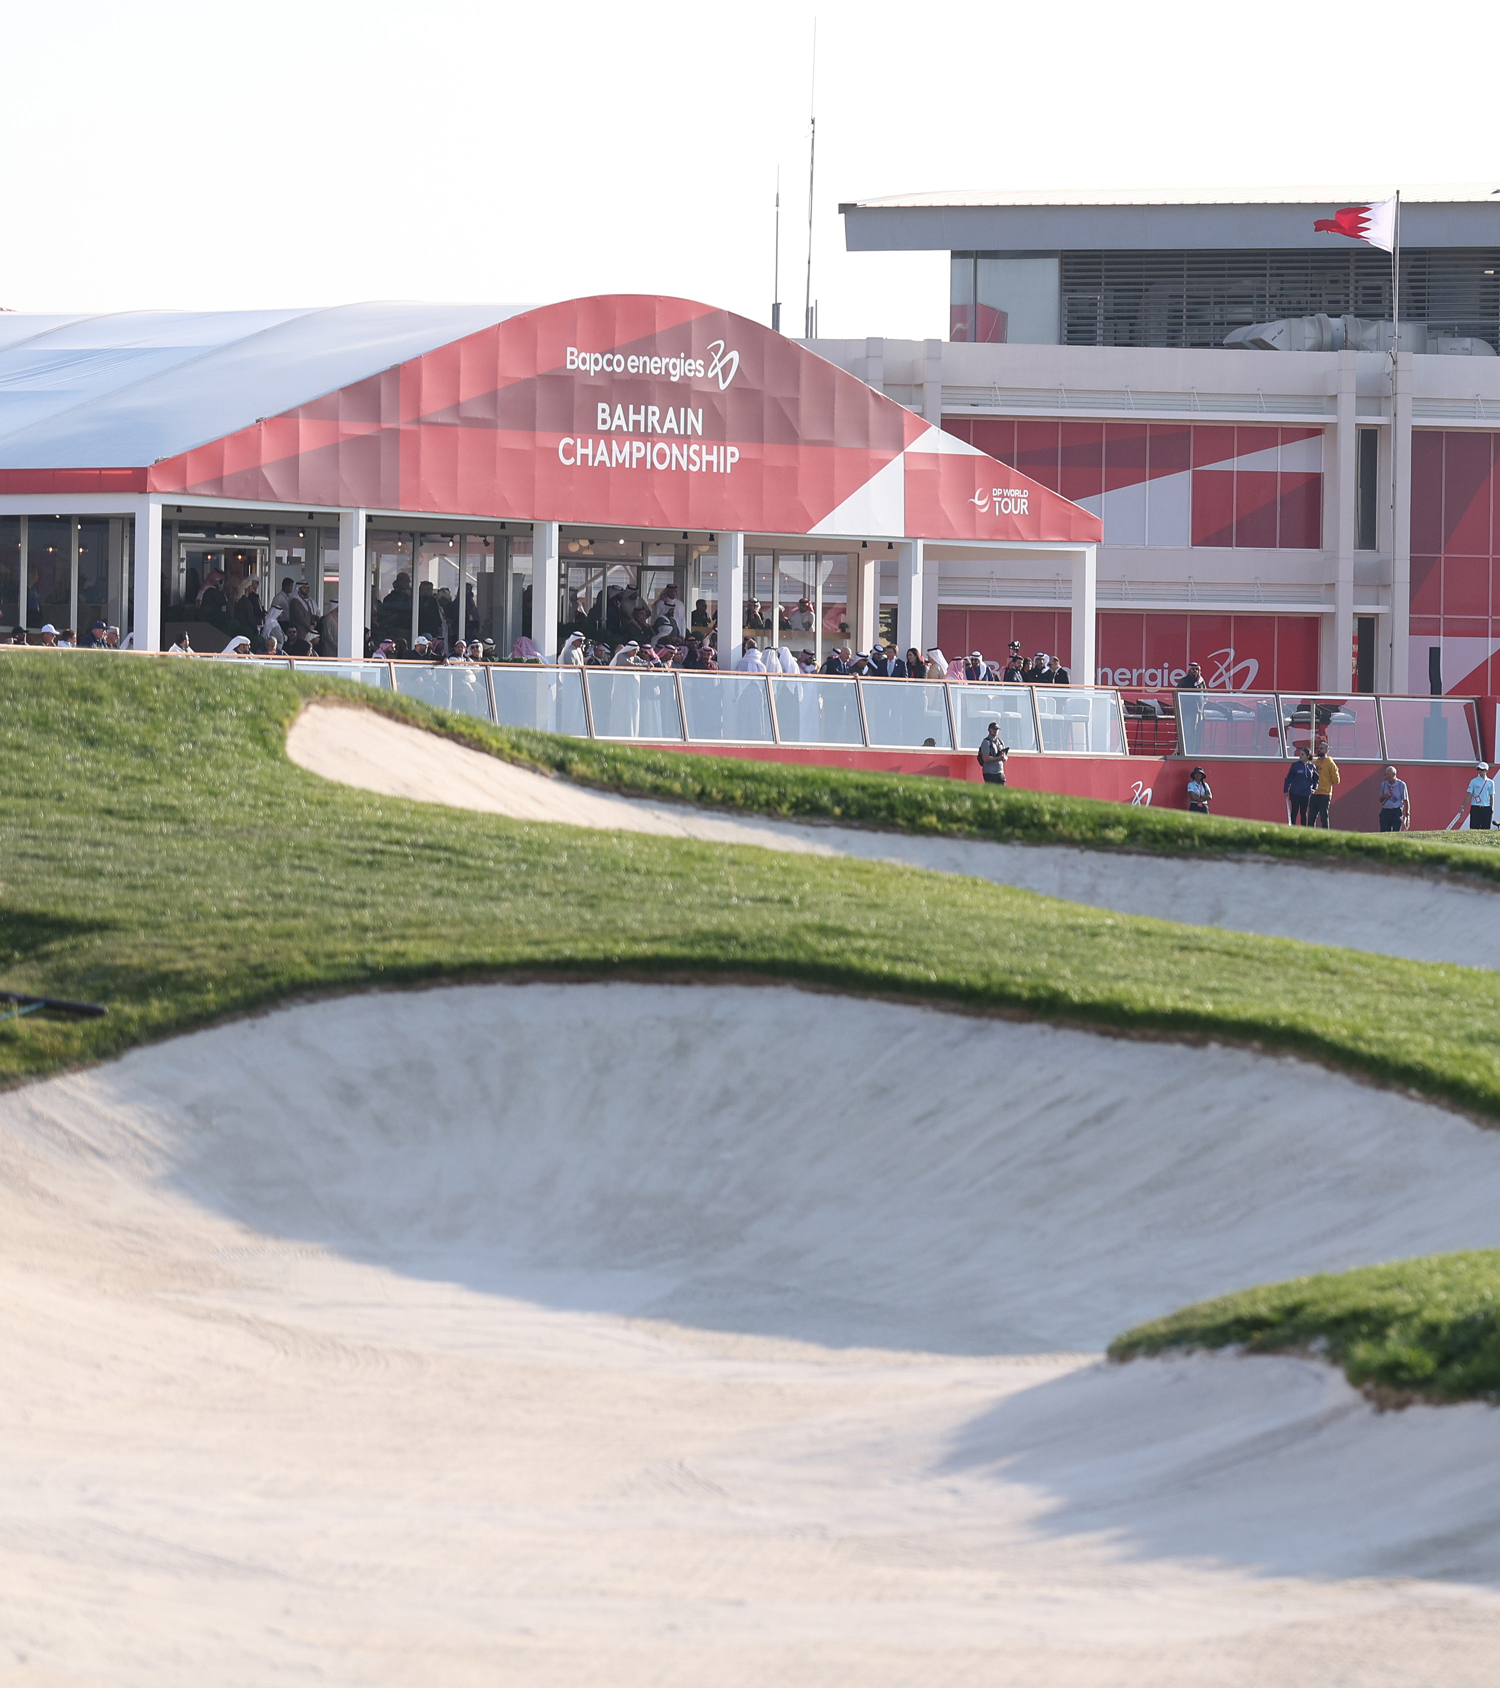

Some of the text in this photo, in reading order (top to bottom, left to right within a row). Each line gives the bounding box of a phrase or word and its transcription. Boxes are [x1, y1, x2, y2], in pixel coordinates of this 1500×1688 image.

[566, 346, 705, 382] Bapco energies
[597, 402, 703, 436] BAHRAIN
[558, 437, 740, 474] CHAMPIONSHIP
[992, 488, 1029, 498] DP WORLD
[992, 497, 1029, 517] TOUR
[1096, 662, 1187, 692] nergie
